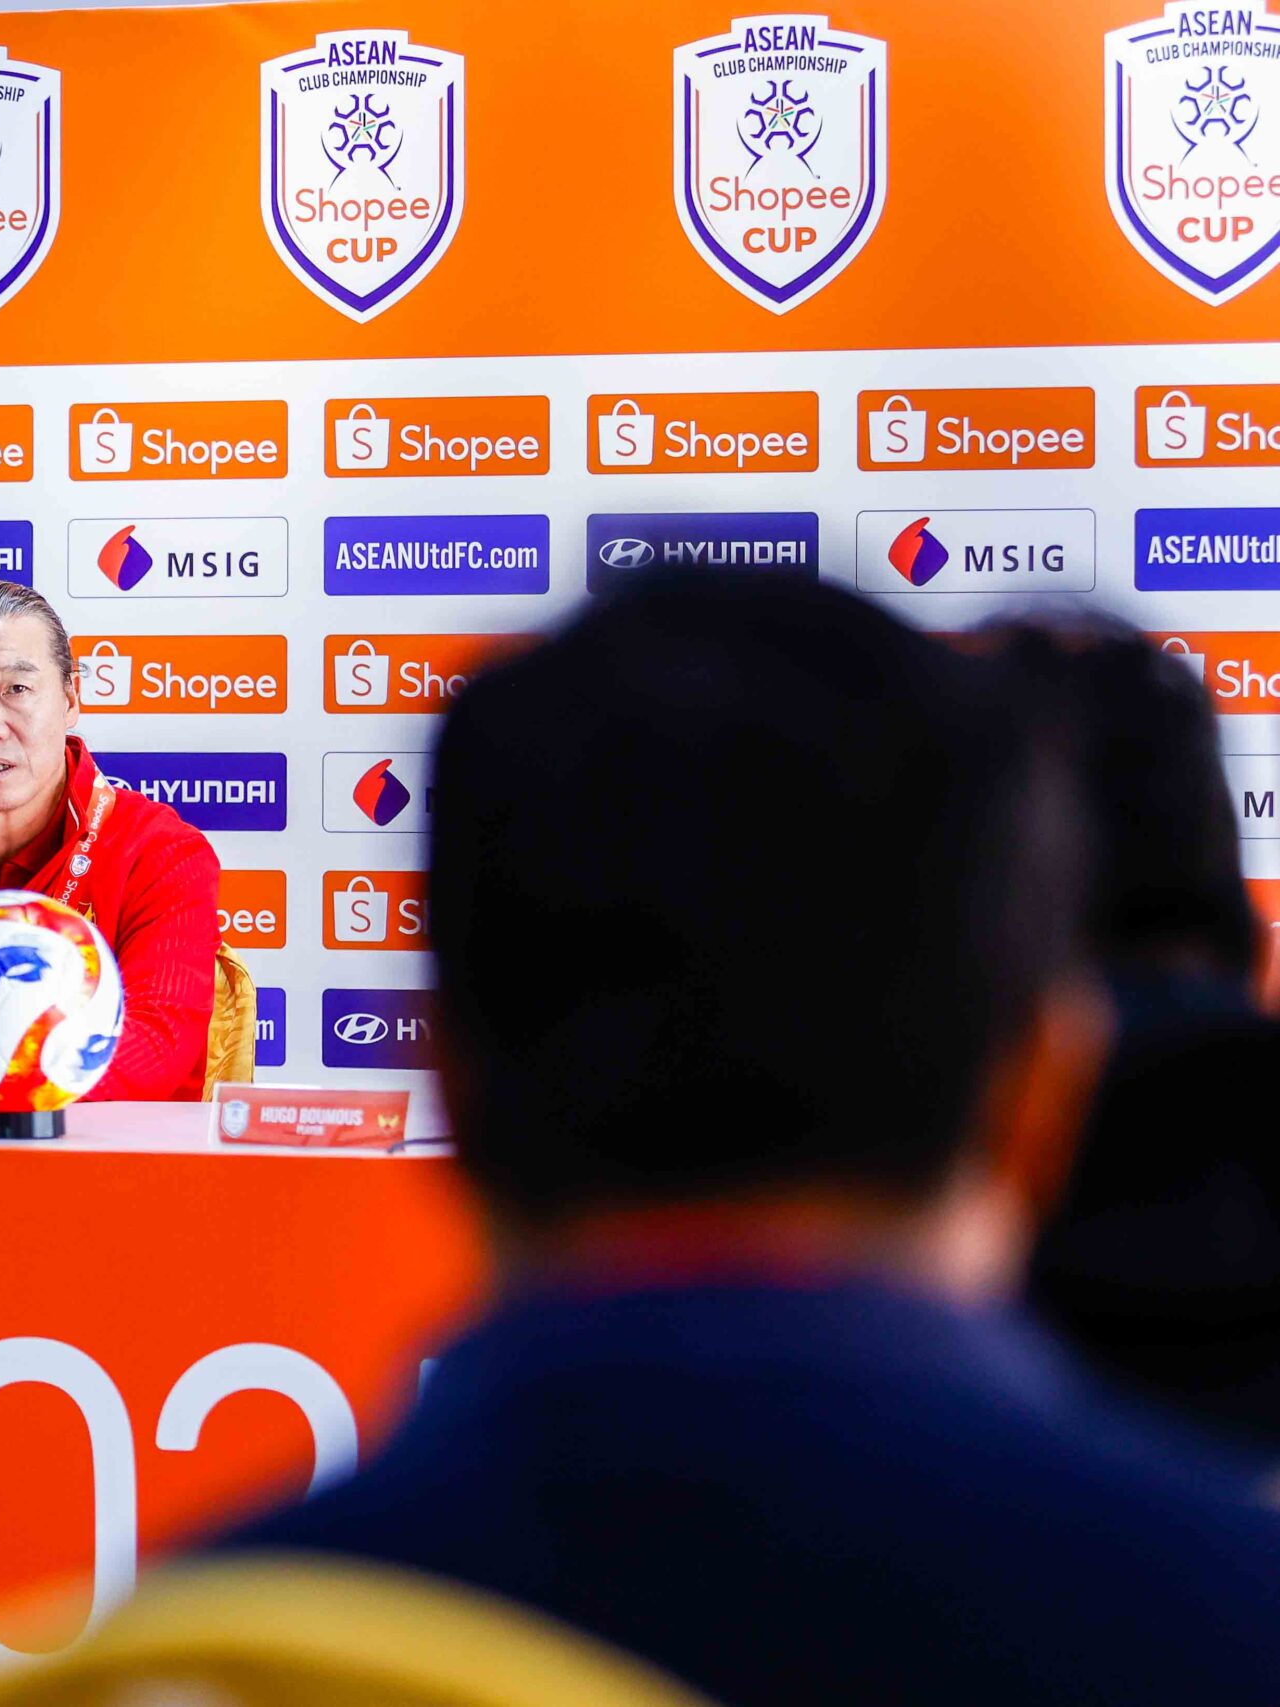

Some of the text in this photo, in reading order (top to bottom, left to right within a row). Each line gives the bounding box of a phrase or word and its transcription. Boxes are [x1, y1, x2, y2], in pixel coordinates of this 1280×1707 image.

[1178, 11, 1252, 38] ASEAN
[744, 27, 816, 53] ASEAN
[1146, 41, 1280, 64] CLUB CHAMPIONSHI
[328, 41, 396, 67] ASEAN
[298, 70, 427, 91] CLUB CHAMPIONSHIP
[713, 58, 848, 78] CLUB CHAMPIONSHIP
[295, 188, 430, 230] Shopee
[709, 177, 850, 221] Shopee
[742, 227, 817, 253] CUP
[1177, 216, 1253, 243] CUP
[326, 237, 398, 263] CUP
[664, 421, 808, 467] Shopee
[936, 416, 1084, 464] Shopee
[1216, 412, 1280, 450] Sho
[142, 429, 278, 474] Shopee
[399, 425, 540, 470] Shopee
[335, 540, 538, 570] ASEANUtdFC.com
[664, 541, 807, 565] HYUNDAI
[964, 544, 1065, 572] MSIG
[1146, 535, 1280, 564] ASEANUtd
[167, 552, 259, 578] MSIG
[142, 663, 277, 708] Shopee
[399, 661, 468, 698] Sho
[1216, 660, 1280, 698] Sho
[140, 779, 276, 804] HYUNDAI
[80, 794, 109, 852] Shopee Cup
[58, 880, 78, 906] Shop
[261, 1107, 297, 1124] HUGO
